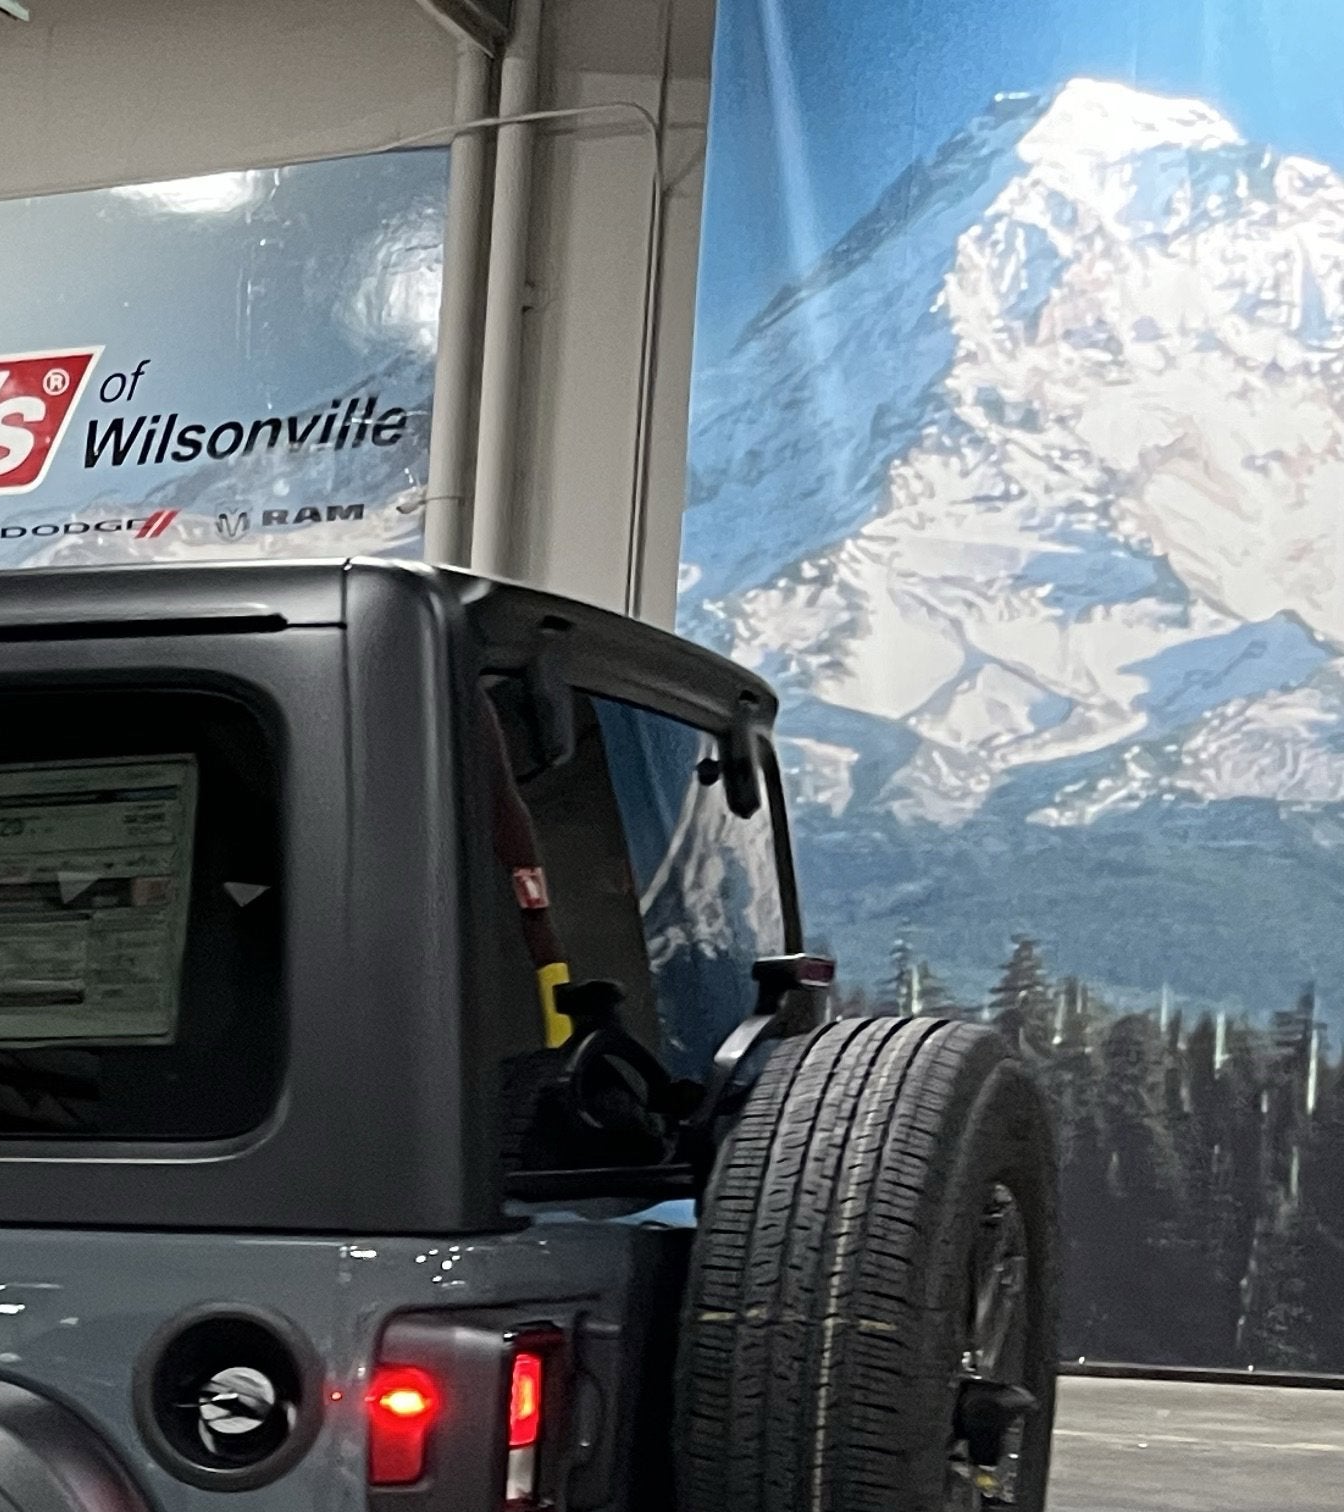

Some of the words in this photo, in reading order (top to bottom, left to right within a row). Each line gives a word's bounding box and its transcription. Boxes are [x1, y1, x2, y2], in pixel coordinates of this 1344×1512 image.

[99, 359, 151, 402] of
[83, 391, 408, 469] Wilsonville
[262, 503, 365, 527] RAM
